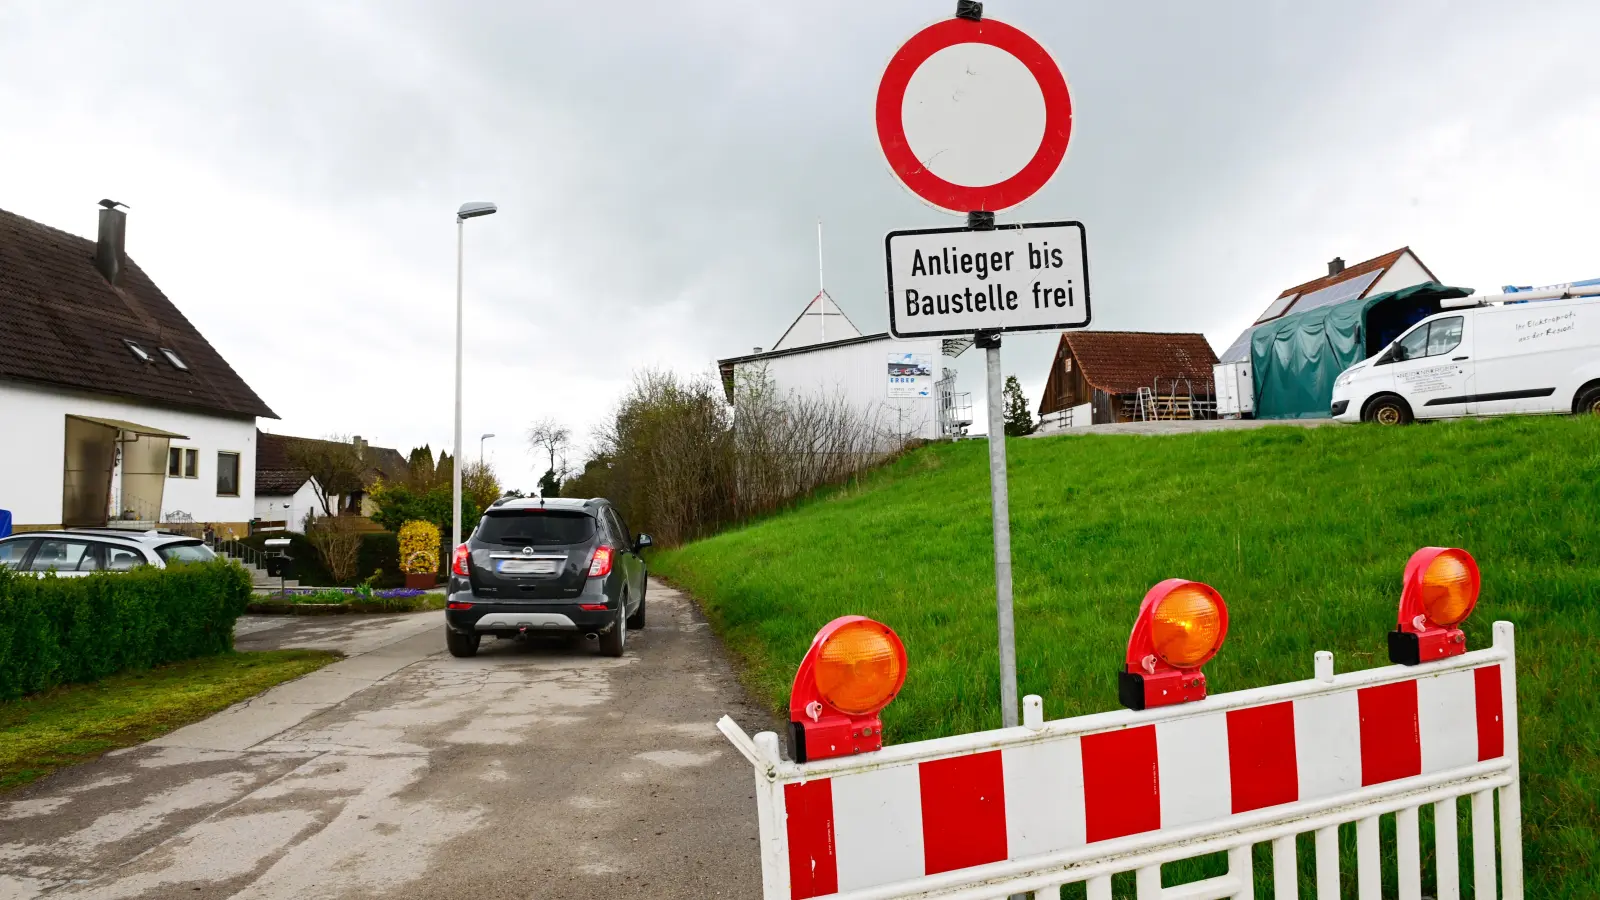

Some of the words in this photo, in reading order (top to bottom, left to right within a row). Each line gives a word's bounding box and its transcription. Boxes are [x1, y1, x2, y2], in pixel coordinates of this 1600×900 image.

[911, 246, 1014, 280] Anlieger
[1028, 241, 1063, 270] bis
[905, 283, 1018, 317] Baustelle
[1032, 279, 1074, 309] frei
